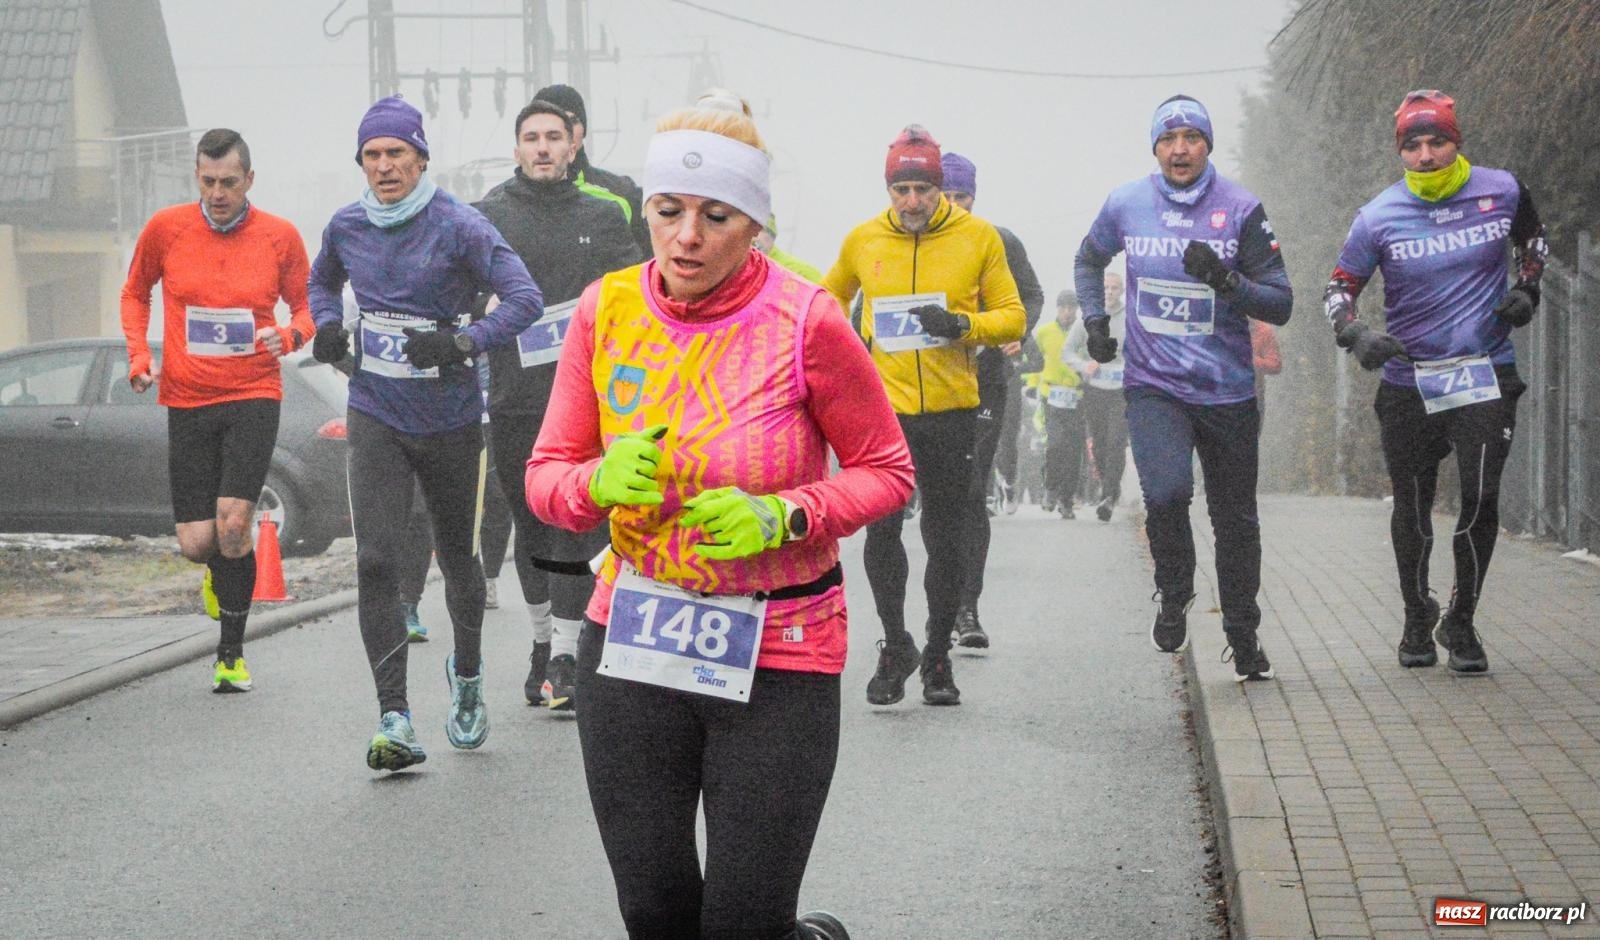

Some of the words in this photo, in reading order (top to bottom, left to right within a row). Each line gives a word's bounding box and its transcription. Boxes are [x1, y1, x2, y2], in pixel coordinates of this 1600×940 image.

[1124, 236, 1239, 260] RUNNRS
[1389, 218, 1512, 260] RUNNERS
[1158, 297, 1191, 321] 94
[213, 323, 228, 344] 3
[1439, 367, 1474, 394] 74
[632, 599, 731, 659] 148
